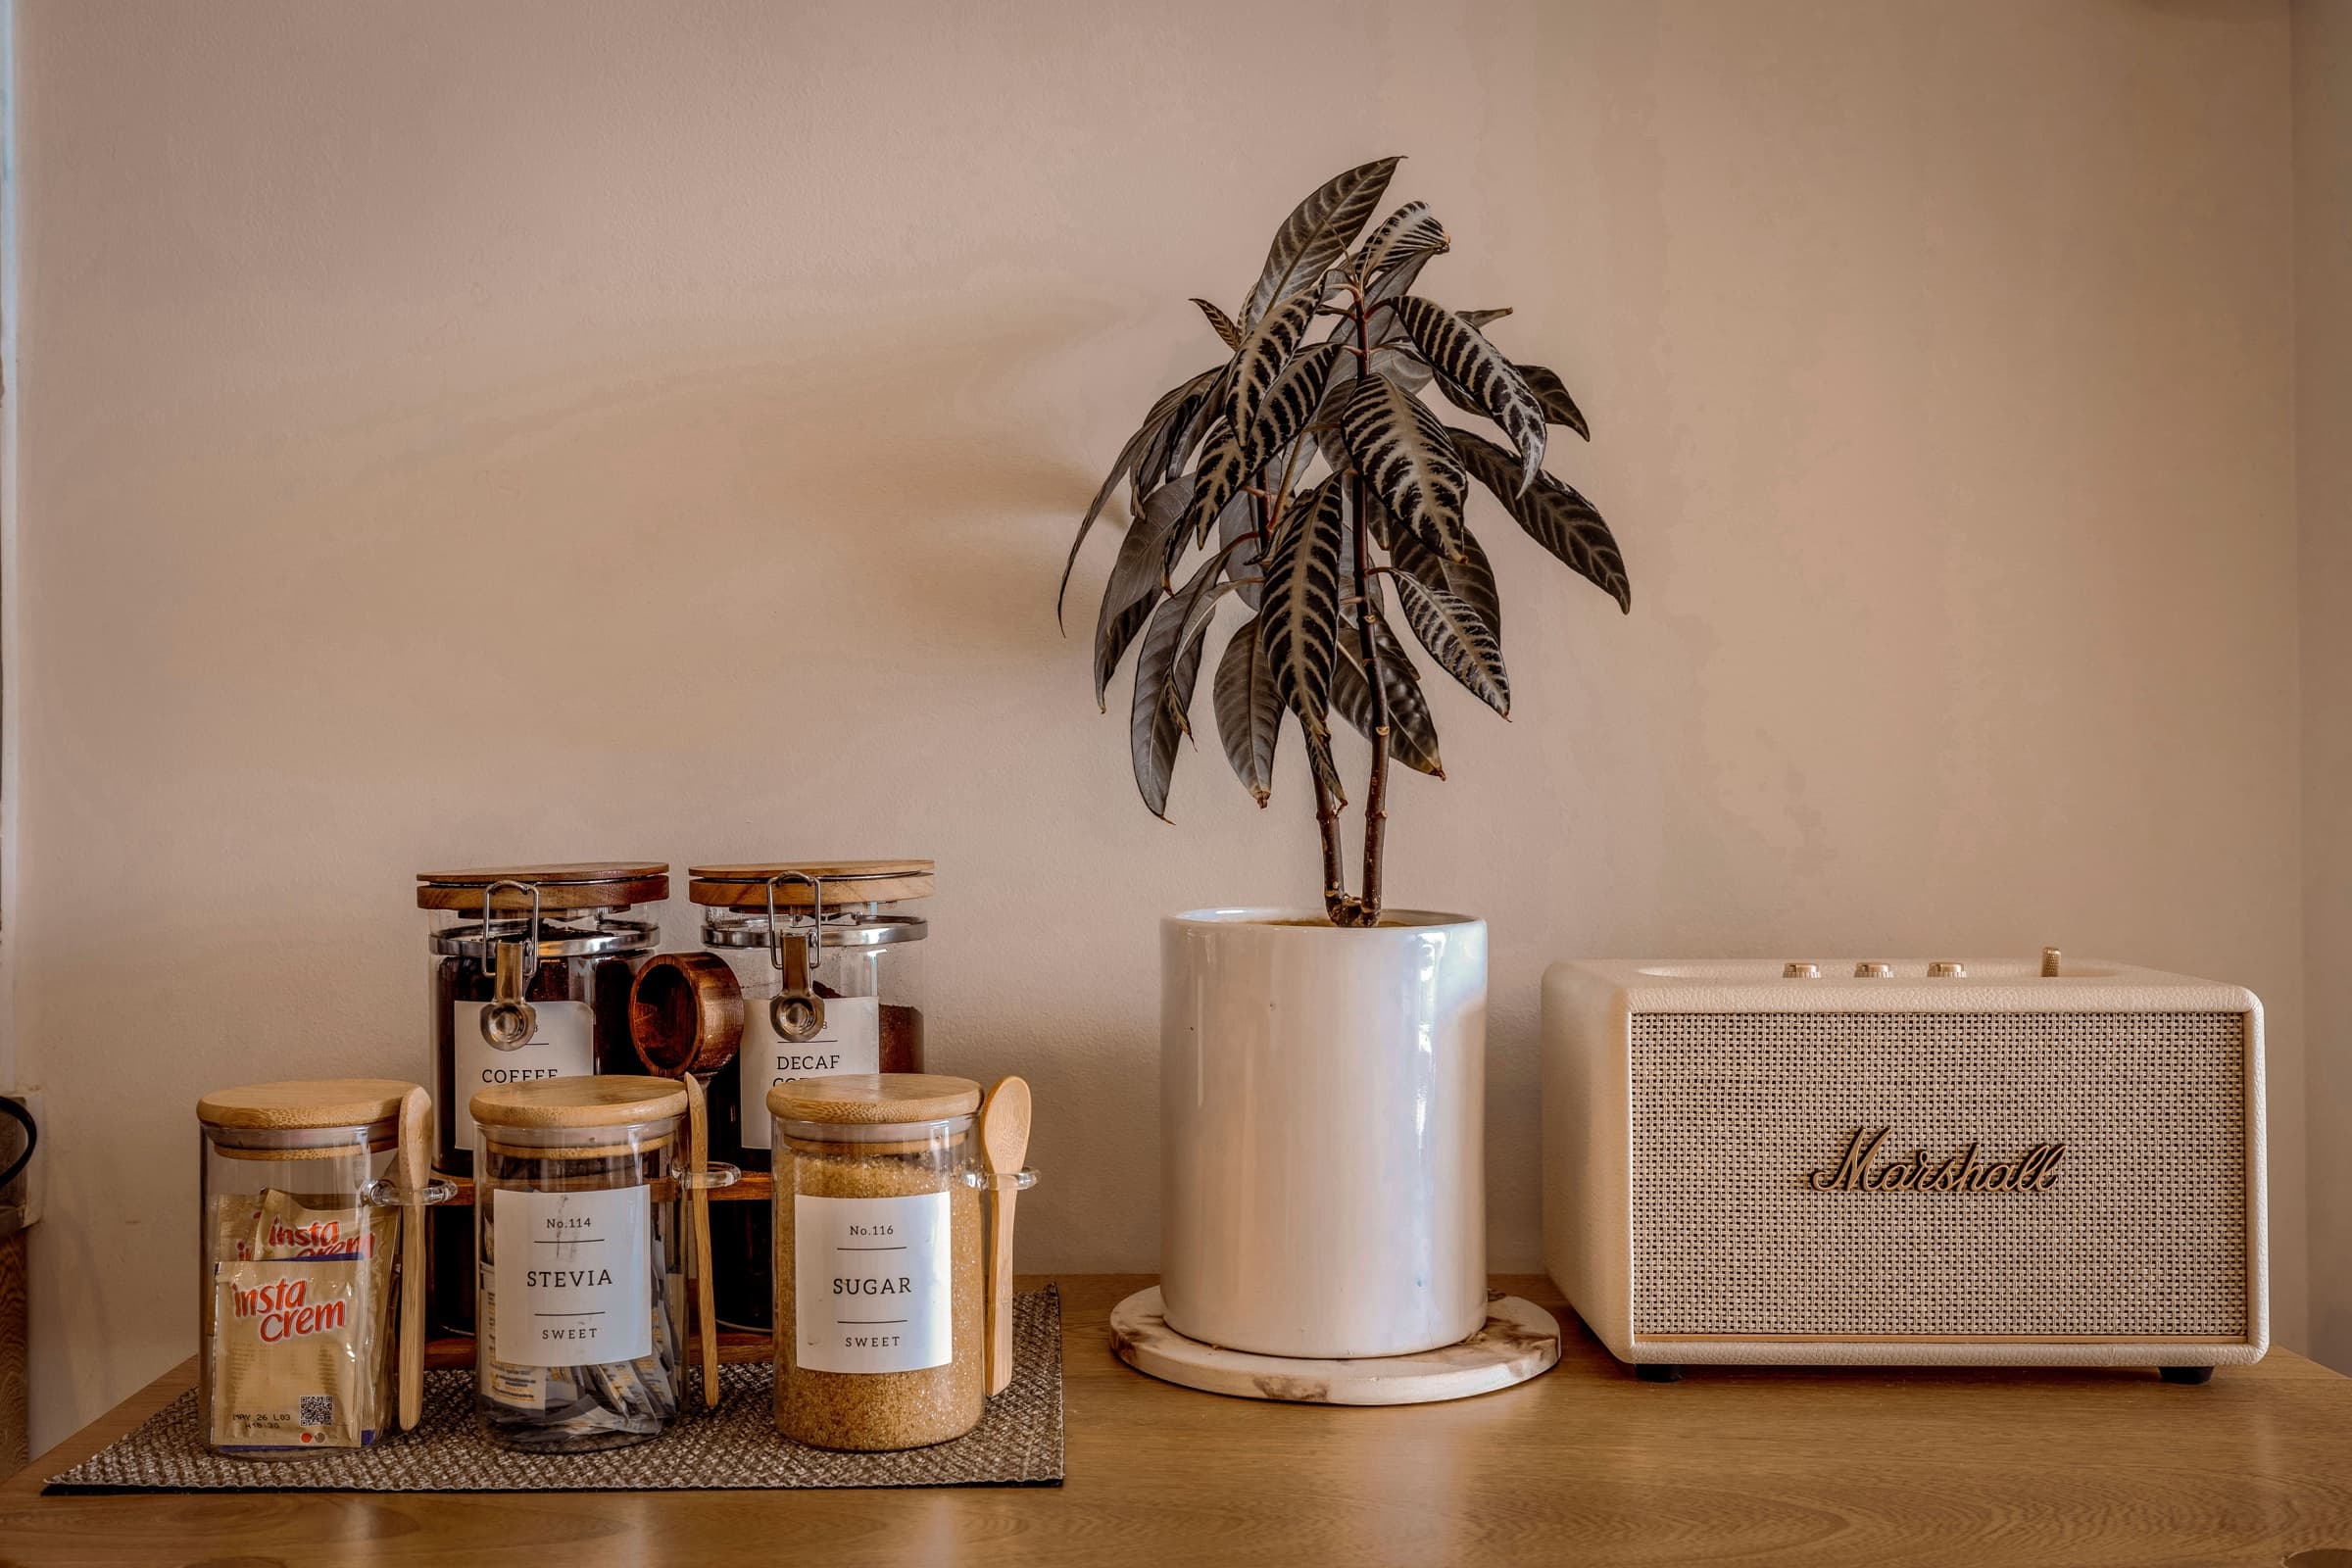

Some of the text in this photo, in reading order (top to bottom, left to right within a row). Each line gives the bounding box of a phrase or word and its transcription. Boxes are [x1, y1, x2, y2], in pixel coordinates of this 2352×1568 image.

[776, 1054, 840, 1070] DECAF
[1811, 1127, 2067, 1192] Marshall
[546, 1217, 592, 1229] No.114
[849, 1225, 895, 1236] No.116
[526, 1269, 612, 1288] STEVIA
[832, 1277, 912, 1296] SUGAR
[231, 1278, 307, 1318] insta
[542, 1328, 598, 1340] SWEET
[845, 1336, 901, 1348] SWEET
